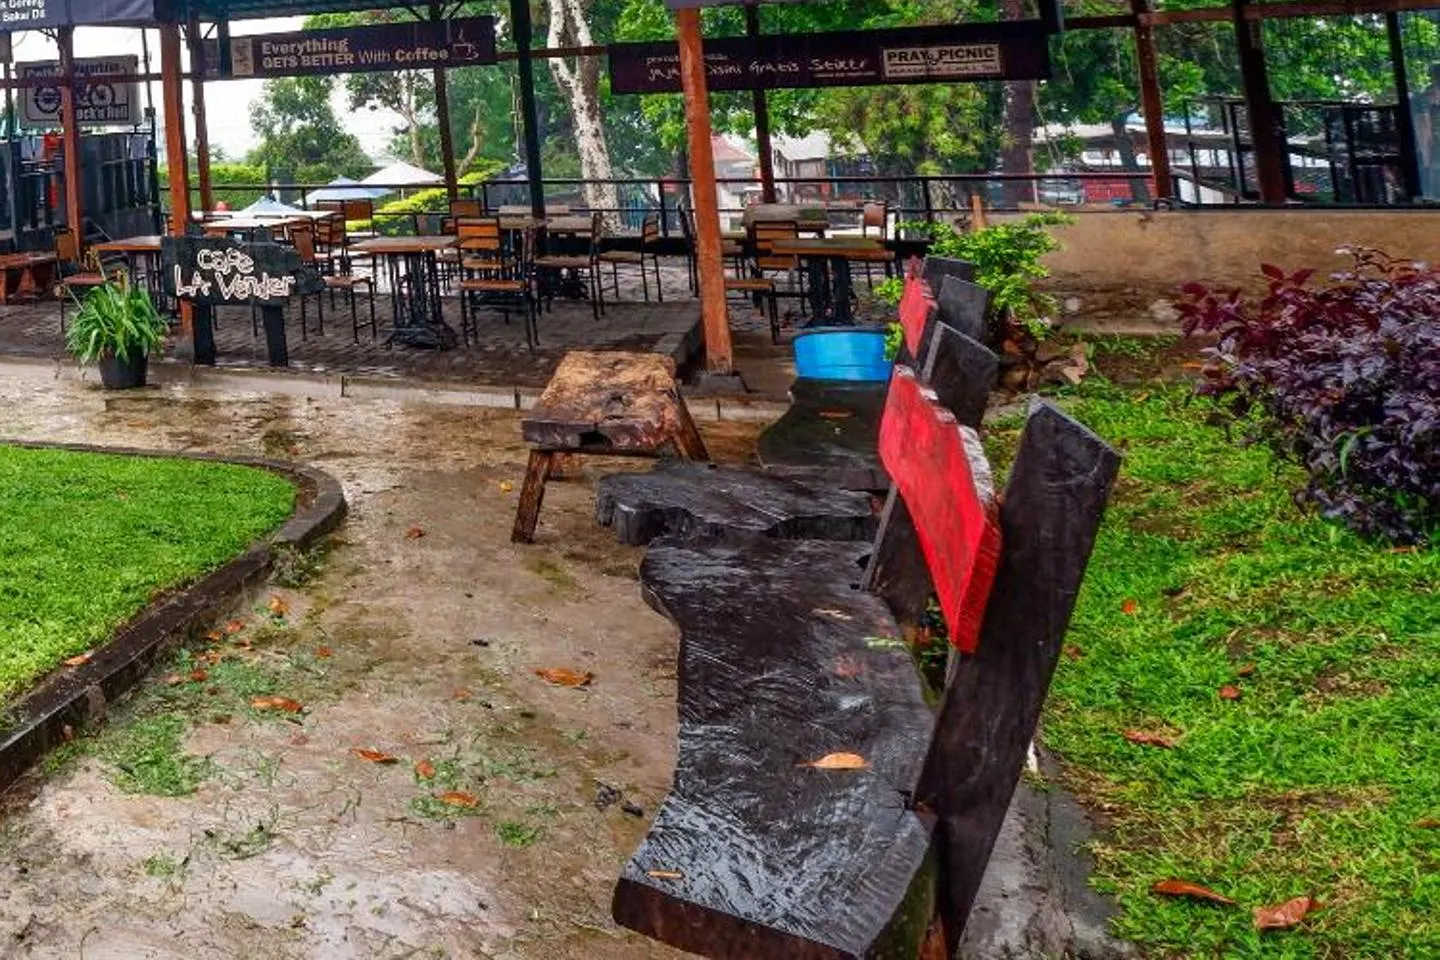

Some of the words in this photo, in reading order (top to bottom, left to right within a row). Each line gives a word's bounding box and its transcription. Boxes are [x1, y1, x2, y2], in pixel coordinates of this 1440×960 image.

[262, 38, 349, 58] Everything
[262, 54, 298, 69] GETS
[300, 52, 355, 67] BETTER
[358, 49, 391, 66] With
[394, 46, 450, 62] Coffee
[887, 49, 928, 63] PRAY
[938, 46, 995, 60] PICNIC
